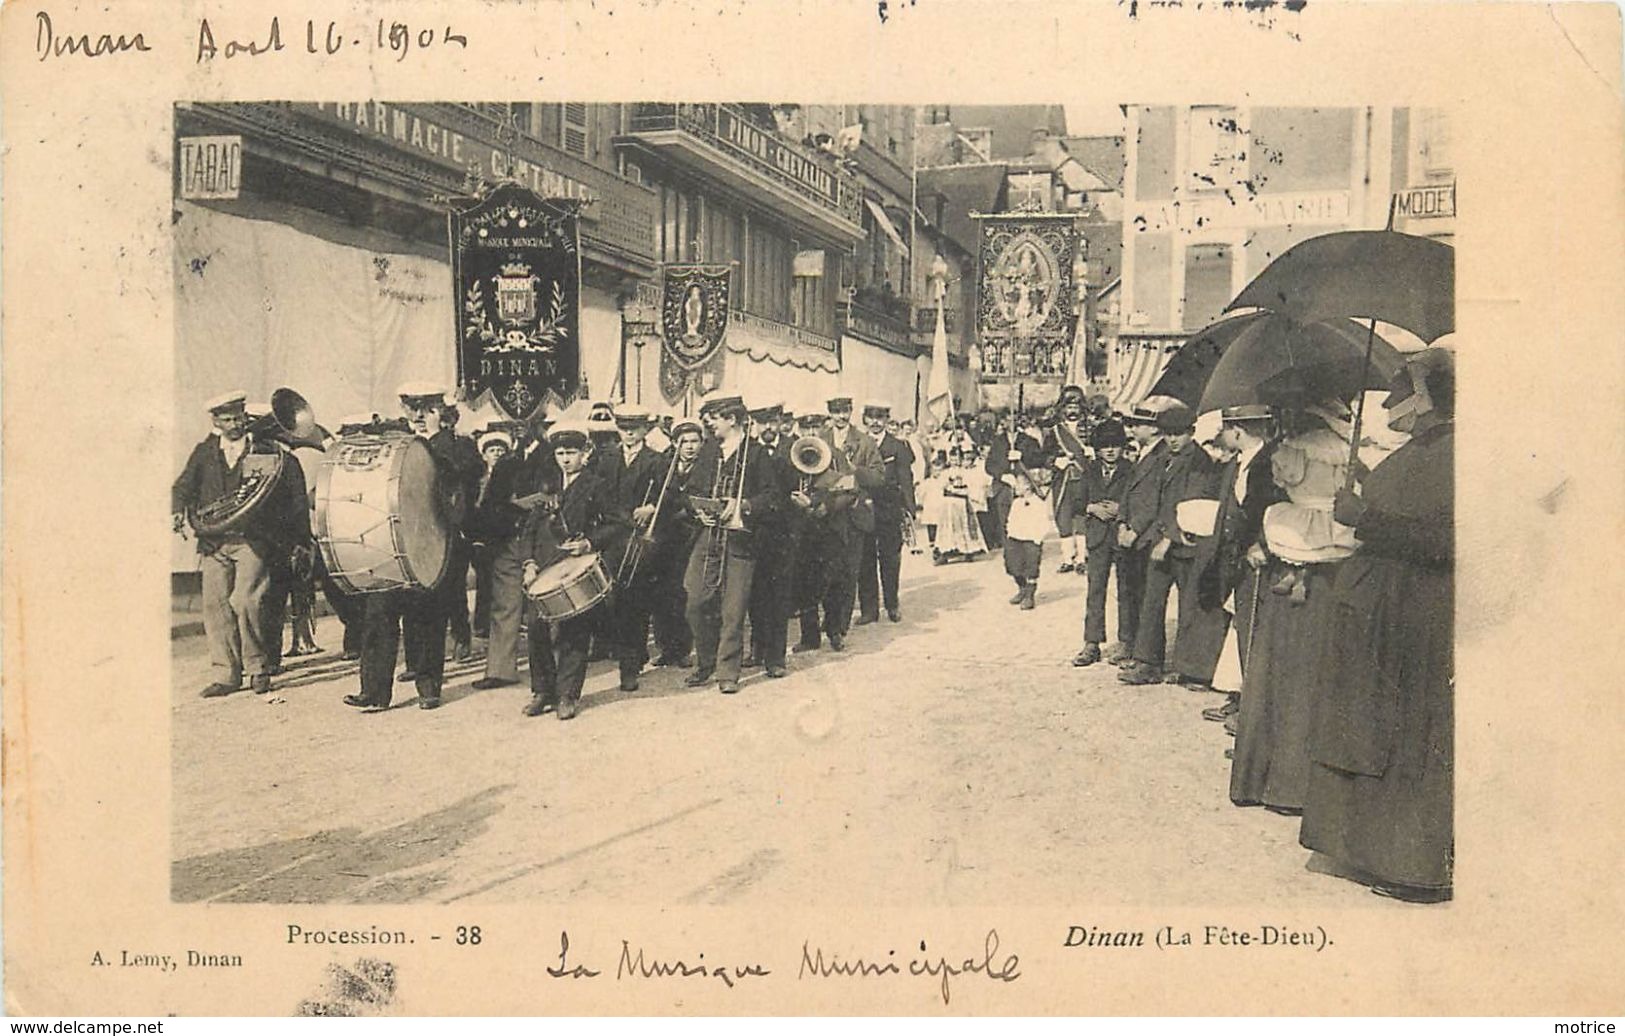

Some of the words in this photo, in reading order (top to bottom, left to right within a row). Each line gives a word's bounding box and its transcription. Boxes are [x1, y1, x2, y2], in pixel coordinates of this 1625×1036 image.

[36, 10, 152, 62] Dinan
[316, 102, 465, 164] HARMACIE
[182, 142, 241, 193] TABAC
[776, 146, 832, 197] CHEVALIER
[1399, 189, 1455, 215] MODE
[480, 358, 558, 377] DINAN
[800, 929, 1022, 1005] Municipale
